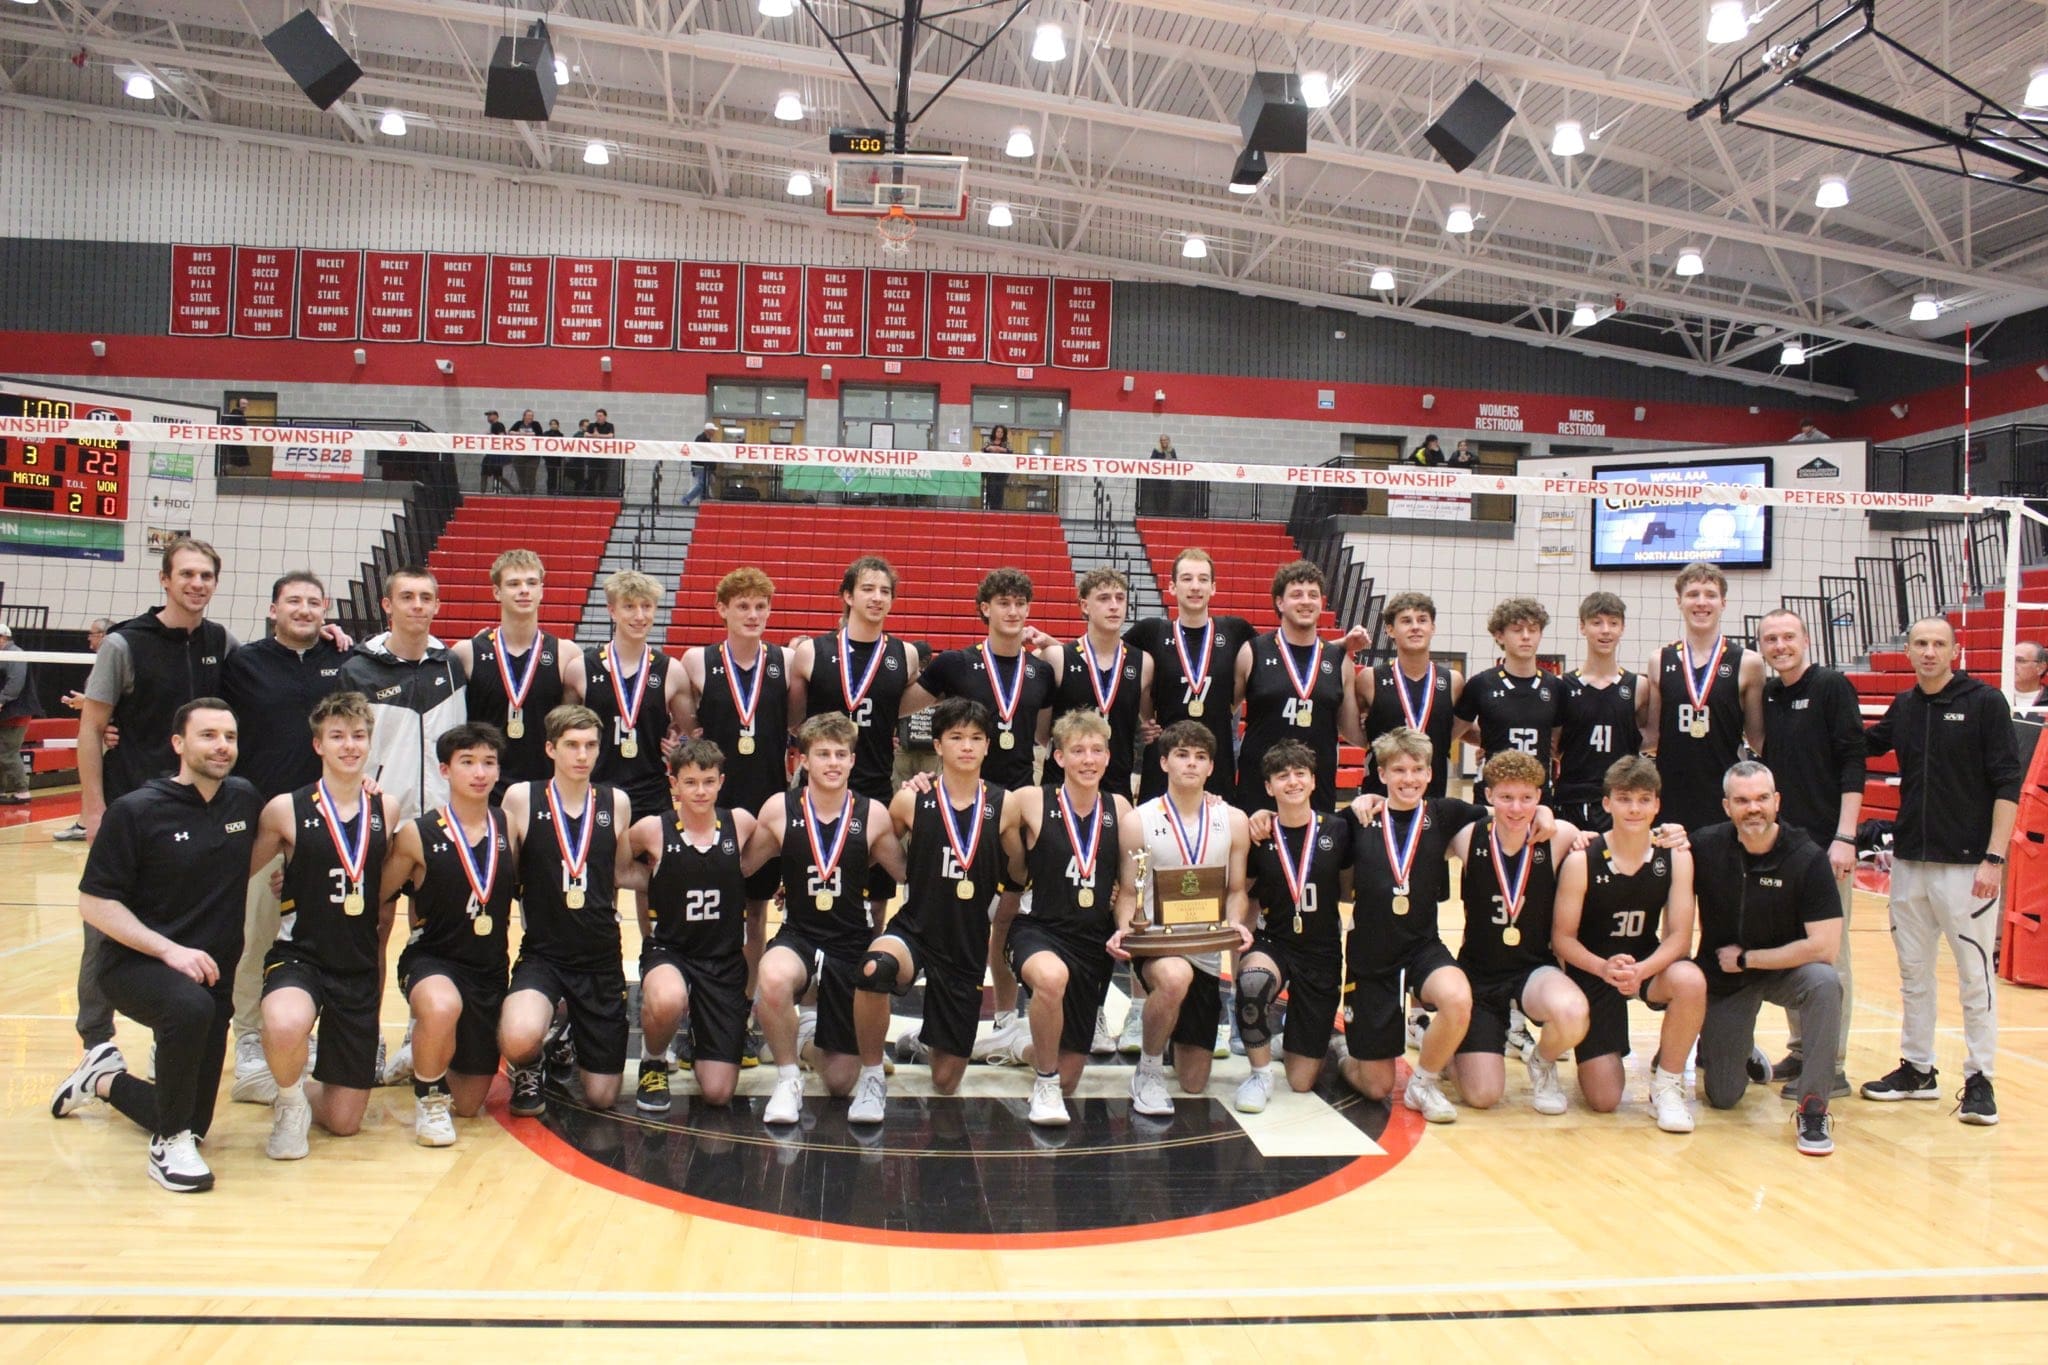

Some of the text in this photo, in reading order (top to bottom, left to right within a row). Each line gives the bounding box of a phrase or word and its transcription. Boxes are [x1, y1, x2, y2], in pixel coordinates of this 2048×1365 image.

[850, 138, 880, 151] 1:00
[193, 252, 211, 261] BOYS
[257, 254, 275, 264] BOYS
[317, 259, 344, 268] HOCKEY
[381, 260, 409, 270] HOCKEY
[444, 262, 471, 271] HOCKEY
[510, 263, 531, 272] GIRLS
[575, 264, 593, 273] BOYS
[188, 266, 215, 275] SOCCER
[252, 268, 279, 277] SOCCER
[636, 265, 657, 275] GIRLS
[700, 269, 720, 278] GIRLS
[762, 271, 783, 280] GIRLS
[825, 274, 845, 283] GIRLS
[191, 280, 211, 288] PIAA
[255, 282, 274, 290] PIAA
[570, 277, 597, 286] SOCCER
[887, 277, 907, 285] GIRLS
[949, 279, 968, 288] GIRLS
[696, 282, 724, 292] SOCCER
[759, 285, 786, 294] SOCCER
[1007, 285, 1033, 294] HOCKEY
[1074, 287, 1091, 295] BOYS
[190, 293, 211, 302] STATE
[318, 290, 340, 299] STATE
[382, 292, 404, 301] STATE
[445, 293, 466, 303] STATE
[510, 290, 528, 299] PIAA
[574, 291, 591, 300] PIAA
[637, 293, 653, 302] PIAA
[884, 289, 910, 299] SOCCER
[253, 295, 274, 304] STATE
[701, 296, 718, 305] PIAA
[763, 298, 780, 307] PIAA
[1069, 300, 1095, 309] SOCCER
[181, 306, 220, 315] CHAMPIONS
[508, 303, 529, 312] STATE
[571, 304, 593, 314] STATE
[826, 301, 843, 310] PIAA
[888, 303, 904, 312] PIAA
[949, 306, 965, 315] PIAA
[244, 308, 283, 318] CHAMPIONS
[308, 306, 349, 316] CHAMPIONS
[372, 308, 413, 317] CHAMPIONS
[435, 309, 476, 319] CHAMPIONS
[635, 306, 656, 316] STATE
[698, 309, 719, 318] STATE
[497, 316, 538, 326] CHAMPIONS
[760, 312, 782, 321] STATE
[823, 314, 845, 324] STATE
[885, 316, 906, 326] STATE
[1008, 316, 1029, 326] STATE
[1074, 313, 1089, 322] PIAA
[561, 318, 602, 327] CHAMPIONS
[624, 320, 664, 330] CHAMPIONS
[946, 319, 967, 328] STATE
[688, 323, 728, 333] CHAMPIONS
[751, 325, 791, 335] CHAMPIONS
[814, 328, 854, 337] CHAMPIONS
[1071, 327, 1092, 336] STATE
[876, 330, 915, 339] CHAMPIONS
[936, 332, 977, 342] CHAMPIONS
[999, 331, 1038, 342] CHAMPIONS
[763, 339, 779, 348] 2011
[826, 341, 842, 350] 2011
[1062, 339, 1100, 349] CHAMPIONS
[1480, 404, 1519, 418] WOMENS
[1569, 409, 1594, 422] MENS
[1476, 417, 1523, 432] RESTROOM
[1558, 422, 1605, 436] RESTROOM
[170, 425, 353, 444] PETERS TOWNSHIP
[78, 438, 118, 449] BUTLER
[452, 435, 636, 455] PETERS TOWNSHIP
[26, 446, 38, 464] 3
[286, 447, 353, 462] FFS B2B
[735, 445, 918, 465] PETERS TOWNSHIP
[86, 451, 117, 476] 22
[1016, 457, 1194, 476] PETERS TOWNSHIP
[13, 472, 50, 486] MATCH
[1288, 468, 1457, 488] PETERS TOWNSHIP
[1685, 471, 1708, 481] AAA
[97, 480, 118, 493] WON
[1544, 479, 1608, 495] PETERS
[1613, 482, 1702, 498] TOWNSHIP
[70, 494, 82, 512] 2
[164, 498, 190, 509] HDG
[1785, 491, 1934, 507] PETERS TOWNSHIP
[104, 498, 115, 515] 0
[1634, 550, 1722, 562] NORTH ALLEGHENY
[1181, 676, 1212, 704] 77
[1509, 728, 1538, 756] 52
[1590, 725, 1612, 752] 41
[942, 846, 966, 880] 12
[807, 865, 842, 898] 23
[686, 889, 720, 922] 22
[1610, 911, 1646, 937] 30
